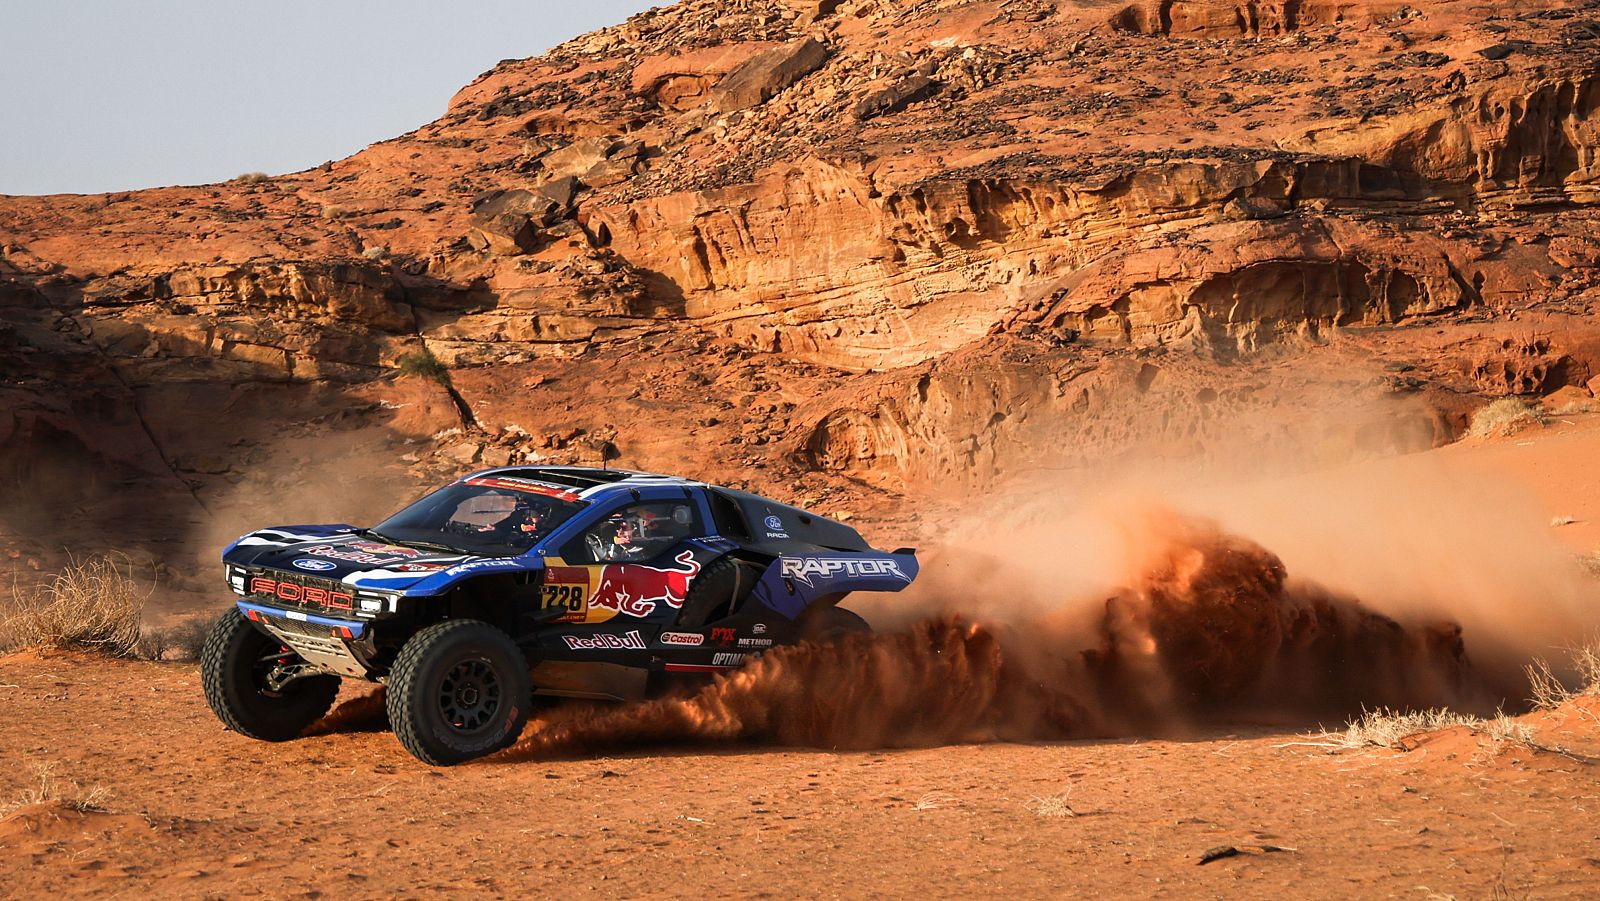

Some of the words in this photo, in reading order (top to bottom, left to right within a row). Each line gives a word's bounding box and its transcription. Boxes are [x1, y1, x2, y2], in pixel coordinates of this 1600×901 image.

[781, 557, 912, 588] RAPTOR
[251, 577, 352, 610] FORD
[547, 585, 583, 611] 228
[562, 634, 608, 650] Red
[602, 630, 646, 649] Bull
[671, 634, 702, 646] Castrol
